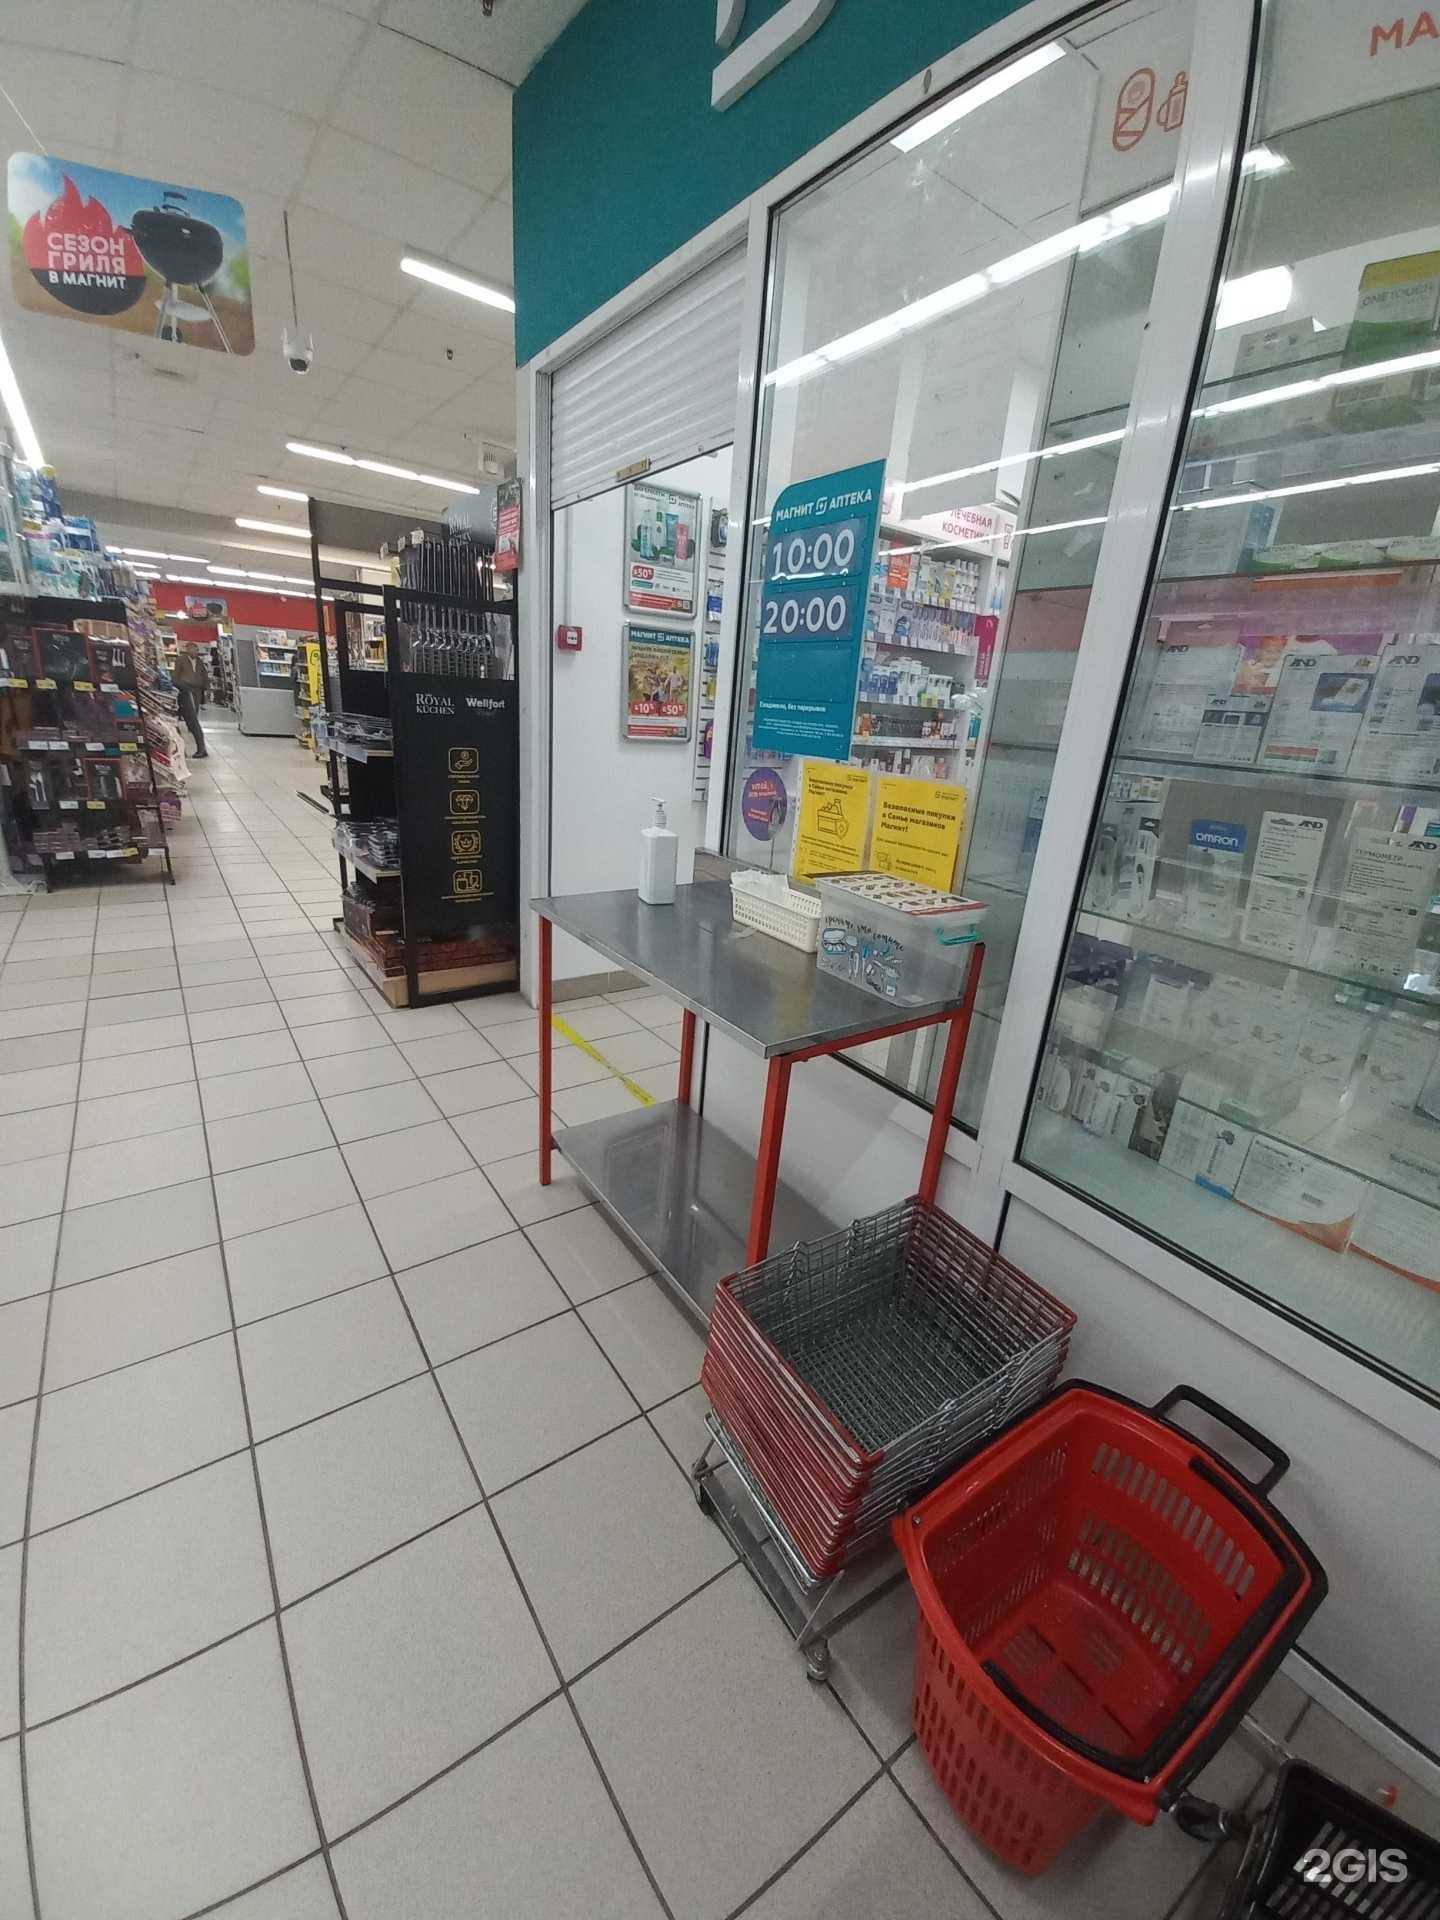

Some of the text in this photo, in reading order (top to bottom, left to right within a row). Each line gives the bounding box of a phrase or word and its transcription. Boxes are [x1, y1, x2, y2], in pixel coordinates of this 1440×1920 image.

[47, 232, 125, 256] СЕЗОН
[47, 251, 126, 274] ГРИЛЯ
[49, 271, 127, 290] В МАГНИТ
[776, 488, 873, 522] МАГНИТ АПТЕКА
[951, 511, 993, 529] ЛЕЧЕБНАЯ
[772, 528, 856, 575] 10:00
[763, 594, 847, 634] 20:00
[631, 630, 657, 639] МАГНИТ
[883, 801, 956, 821] Безопасные покупки
[881, 821, 909, 833] Магнит!
[909, 817, 946, 830] магазинов
